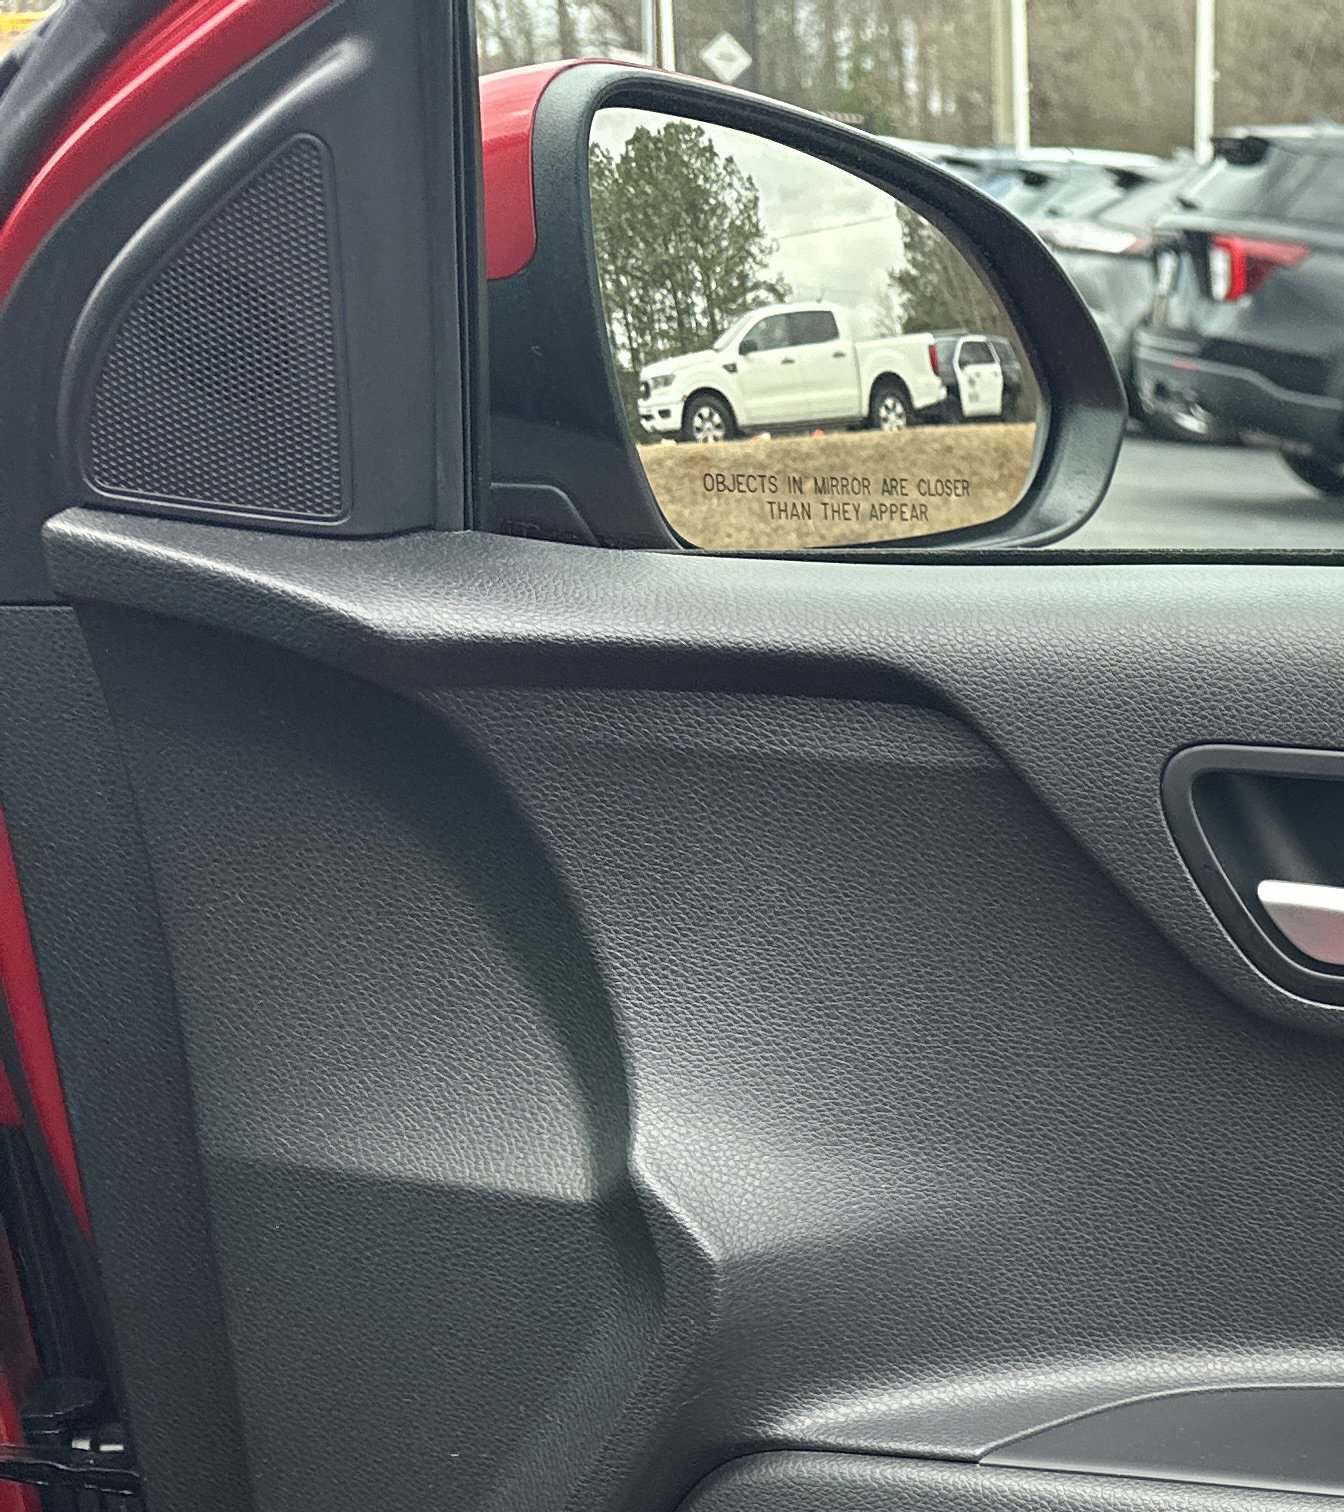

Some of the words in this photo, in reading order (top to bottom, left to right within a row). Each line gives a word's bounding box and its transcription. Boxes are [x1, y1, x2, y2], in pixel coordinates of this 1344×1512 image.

[703, 473, 778, 494] OBJECTS
[787, 475, 804, 495] IN
[813, 476, 871, 496] MIRROR
[881, 478, 909, 497] ARE
[917, 478, 970, 497] CLOSER
[767, 501, 812, 521] THAN
[820, 502, 861, 521] THEY
[869, 503, 930, 522] APPEAR
